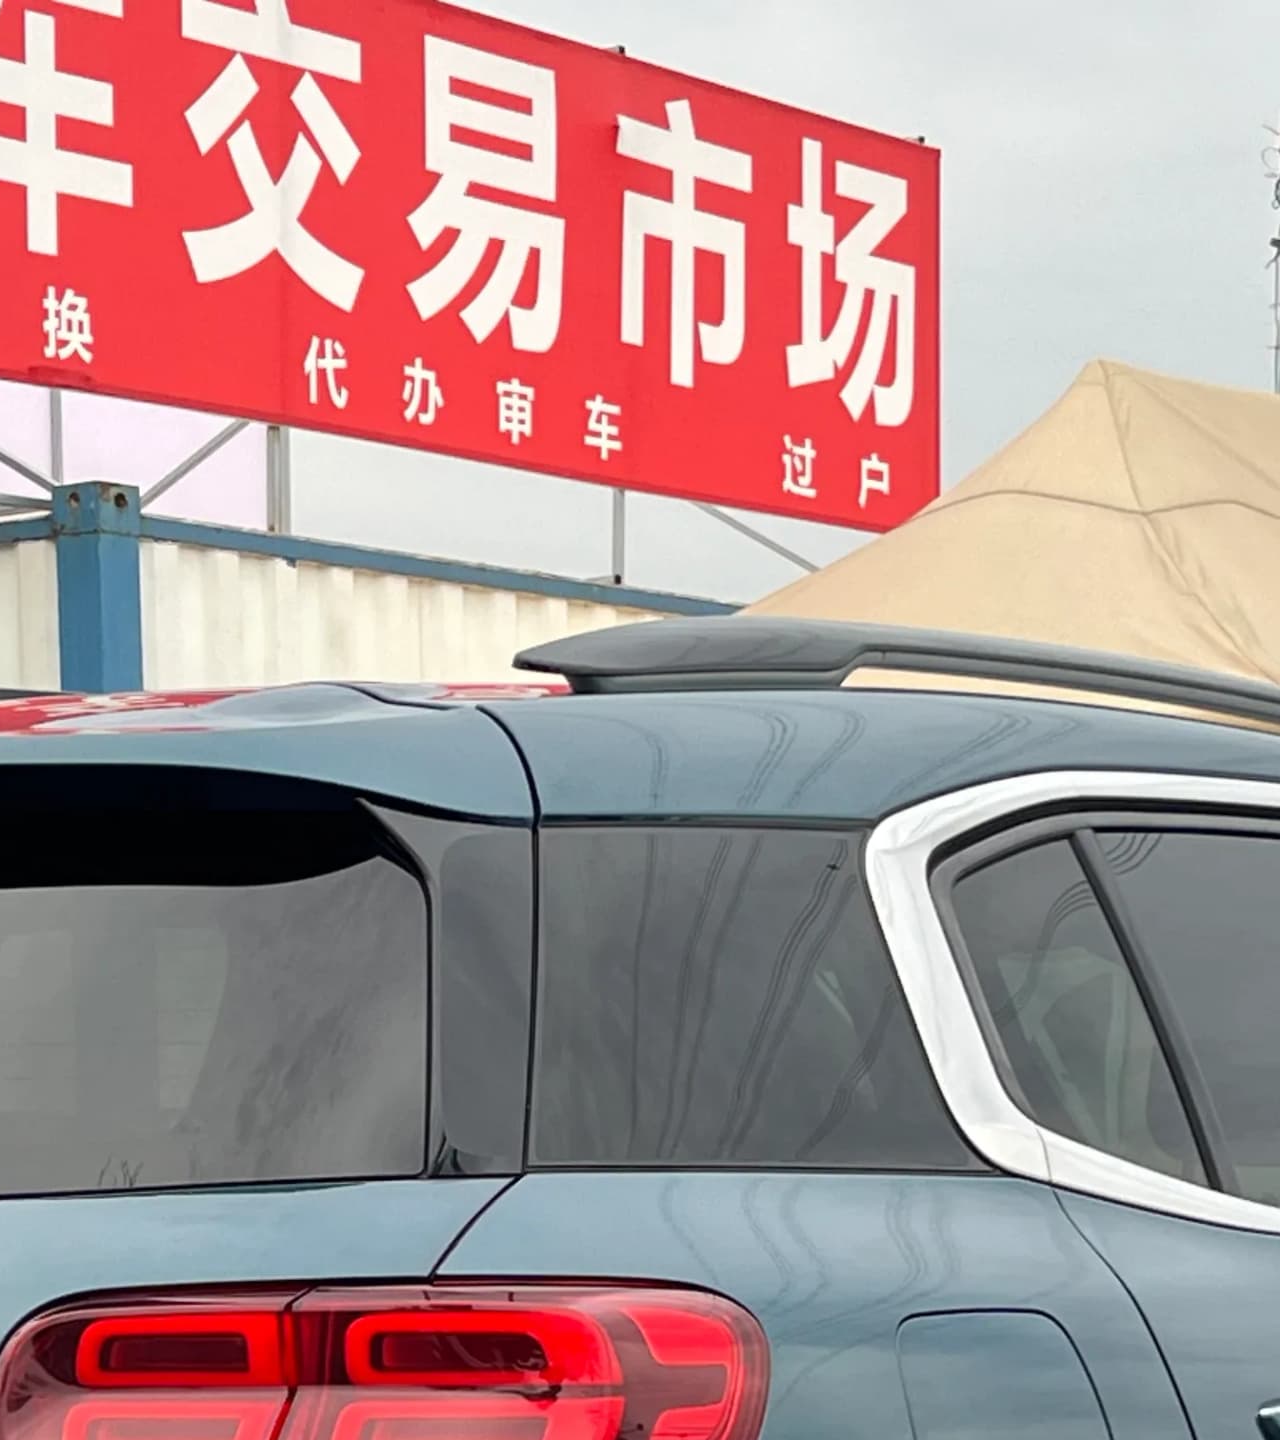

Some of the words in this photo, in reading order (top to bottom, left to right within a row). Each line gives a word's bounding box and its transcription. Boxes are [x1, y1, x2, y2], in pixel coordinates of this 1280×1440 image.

[303, 335, 624, 460] 代办审车
[781, 435, 890, 508] 过户
